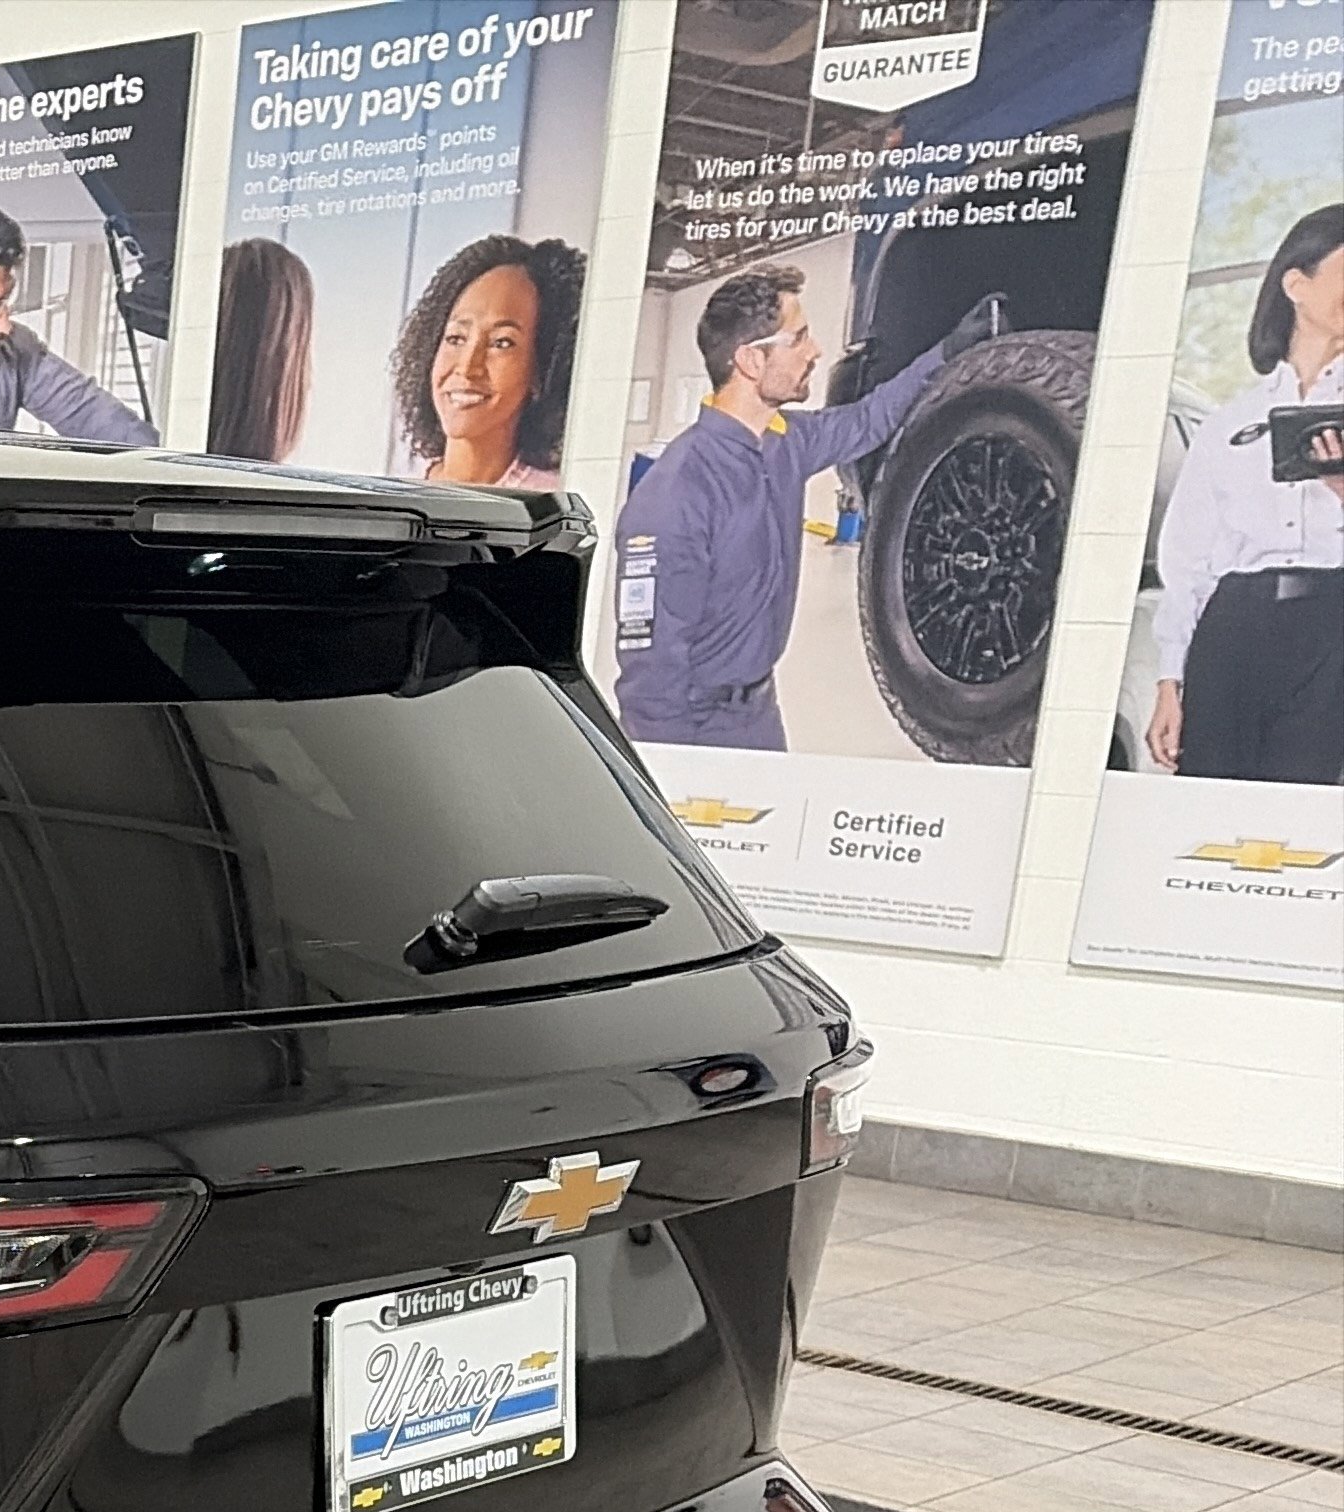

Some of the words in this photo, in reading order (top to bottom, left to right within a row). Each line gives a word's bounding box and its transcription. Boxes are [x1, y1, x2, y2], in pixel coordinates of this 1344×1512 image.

[860, 0, 947, 30] MATCH
[255, 42, 362, 84] Taking
[371, 32, 450, 70] care
[458, 14, 499, 56] of
[504, 8, 593, 57] your
[824, 48, 972, 83] GUARANTEE
[1251, 36, 1300, 61] The
[1305, 35, 1344, 61] pe
[31, 73, 144, 121] experts
[251, 90, 353, 130] Chevy
[359, 80, 441, 126] pays
[451, 62, 508, 105] off
[1243, 67, 1341, 102] getting
[9, 128, 89, 156] technicians
[91, 125, 132, 145] know
[247, 151, 276, 168] Use
[280, 149, 318, 170] your
[320, 141, 349, 161] GM
[440, 125, 496, 149] points
[696, 156, 756, 180] When
[760, 153, 793, 176] it's
[796, 150, 845, 172] time
[852, 148, 875, 169] to
[879, 142, 961, 168] replace
[966, 138, 1019, 164] your
[1024, 132, 1084, 156] tires,
[28, 160, 60, 178] than
[63, 152, 119, 176] anyone.
[244, 180, 264, 195] on
[268, 169, 338, 193] Certified
[342, 163, 408, 187] Service,
[414, 153, 493, 178] including
[498, 146, 520, 167] oil
[687, 190, 714, 210] let
[719, 188, 743, 207] us
[748, 185, 775, 206] do
[780, 182, 814, 204] the
[819, 178, 878, 201] work.
[883, 174, 920, 197] We
[924, 171, 978, 194] have
[984, 167, 1021, 190] the
[1026, 162, 1085, 189] right
[241, 203, 311, 223] changes,
[317, 196, 345, 216] tire
[350, 188, 426, 213] rotations
[431, 183, 465, 204] and
[468, 179, 521, 199] more.
[685, 219, 731, 240] tires
[735, 215, 767, 237] for
[769, 218, 815, 242] your
[821, 210, 890, 236] Chevy
[893, 208, 916, 229] at
[921, 204, 959, 226] the
[963, 200, 1017, 224] best
[1020, 195, 1076, 219] deal.
[833, 809, 945, 838] Certified
[829, 837, 923, 864] Service
[1166, 878, 1344, 901] CHEVROLET
[399, 1289, 465, 1319] Uftring
[468, 1274, 523, 1302] Chevy
[366, 1342, 514, 1460] Uftring
[518, 1371, 556, 1388] CHEVROLET
[405, 1412, 471, 1440] WASHINGTON
[399, 1445, 519, 1497] Washington
